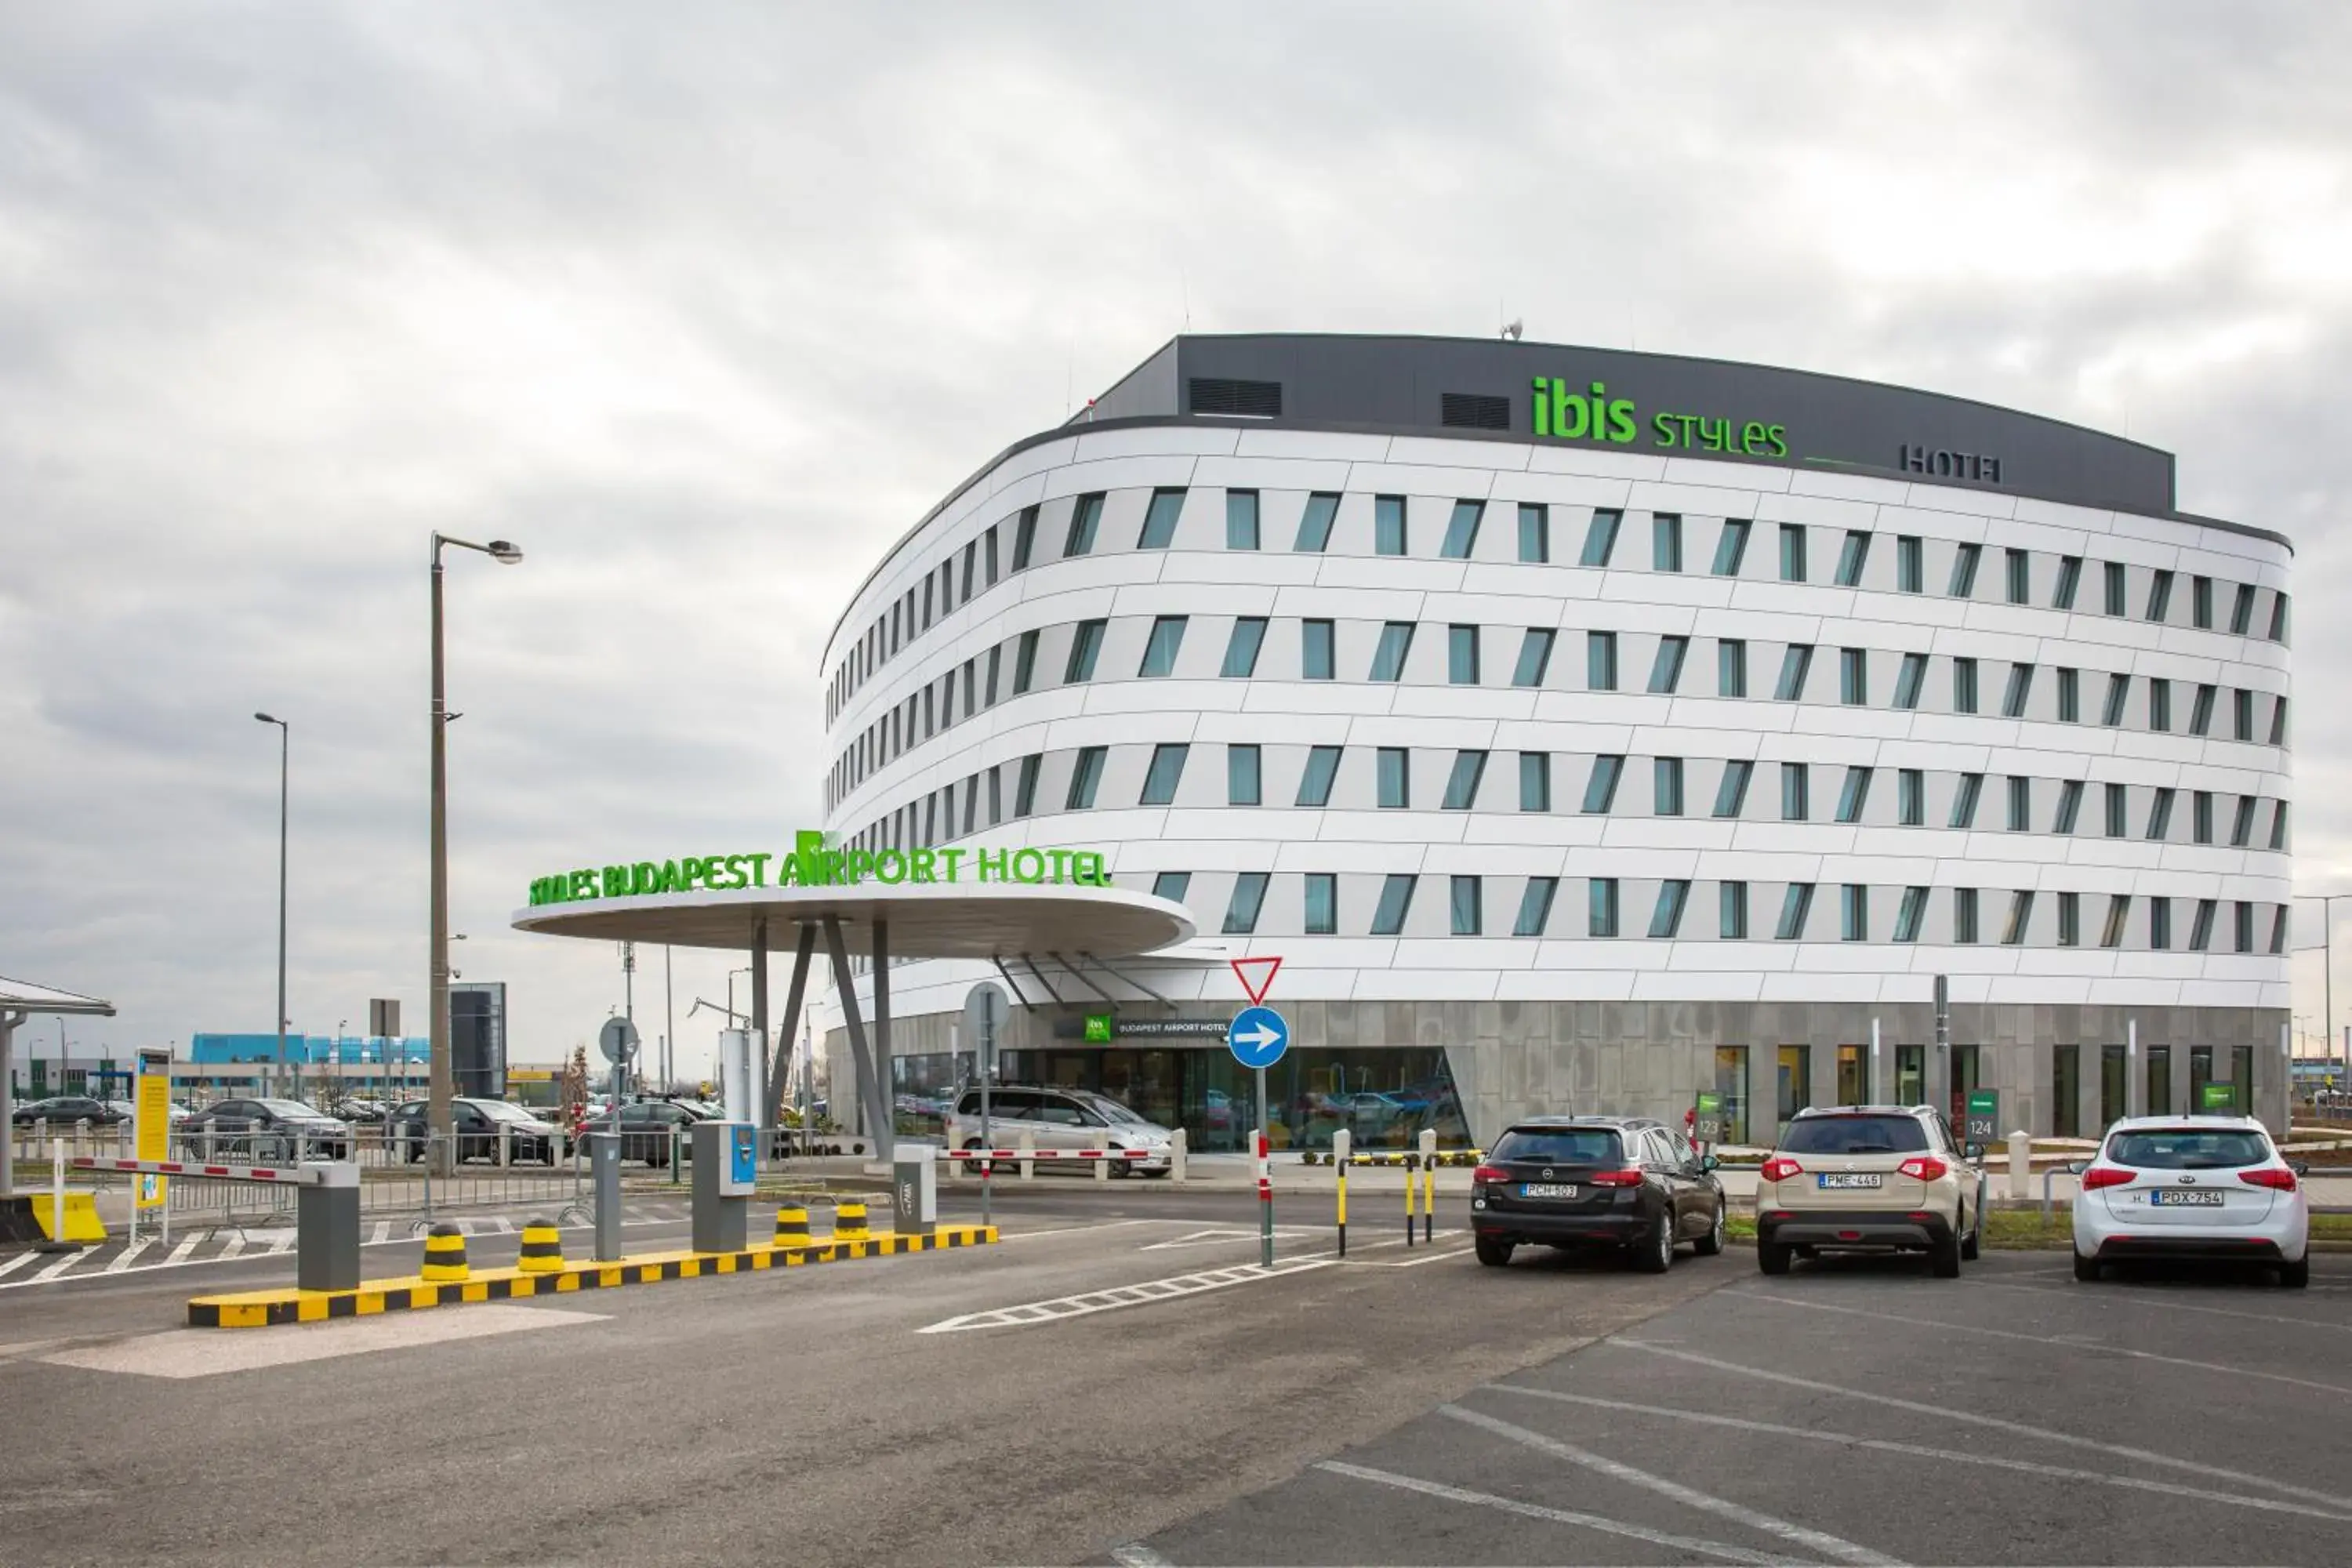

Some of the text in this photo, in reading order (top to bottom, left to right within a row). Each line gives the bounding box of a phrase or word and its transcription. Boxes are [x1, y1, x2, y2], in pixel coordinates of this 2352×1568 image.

[1533, 376, 1637, 443] ibis
[602, 852, 772, 898] BUDAPEST
[778, 847, 967, 887] AIRPORT
[978, 848, 1114, 887] HOTEL
[1119, 1023, 1229, 1033] BUDAPEST AIRPORT HOTEL
[1700, 1120, 1719, 1134] 123
[1970, 1120, 1992, 1135] 124
[2161, 1192, 2220, 1203] PDX-754
